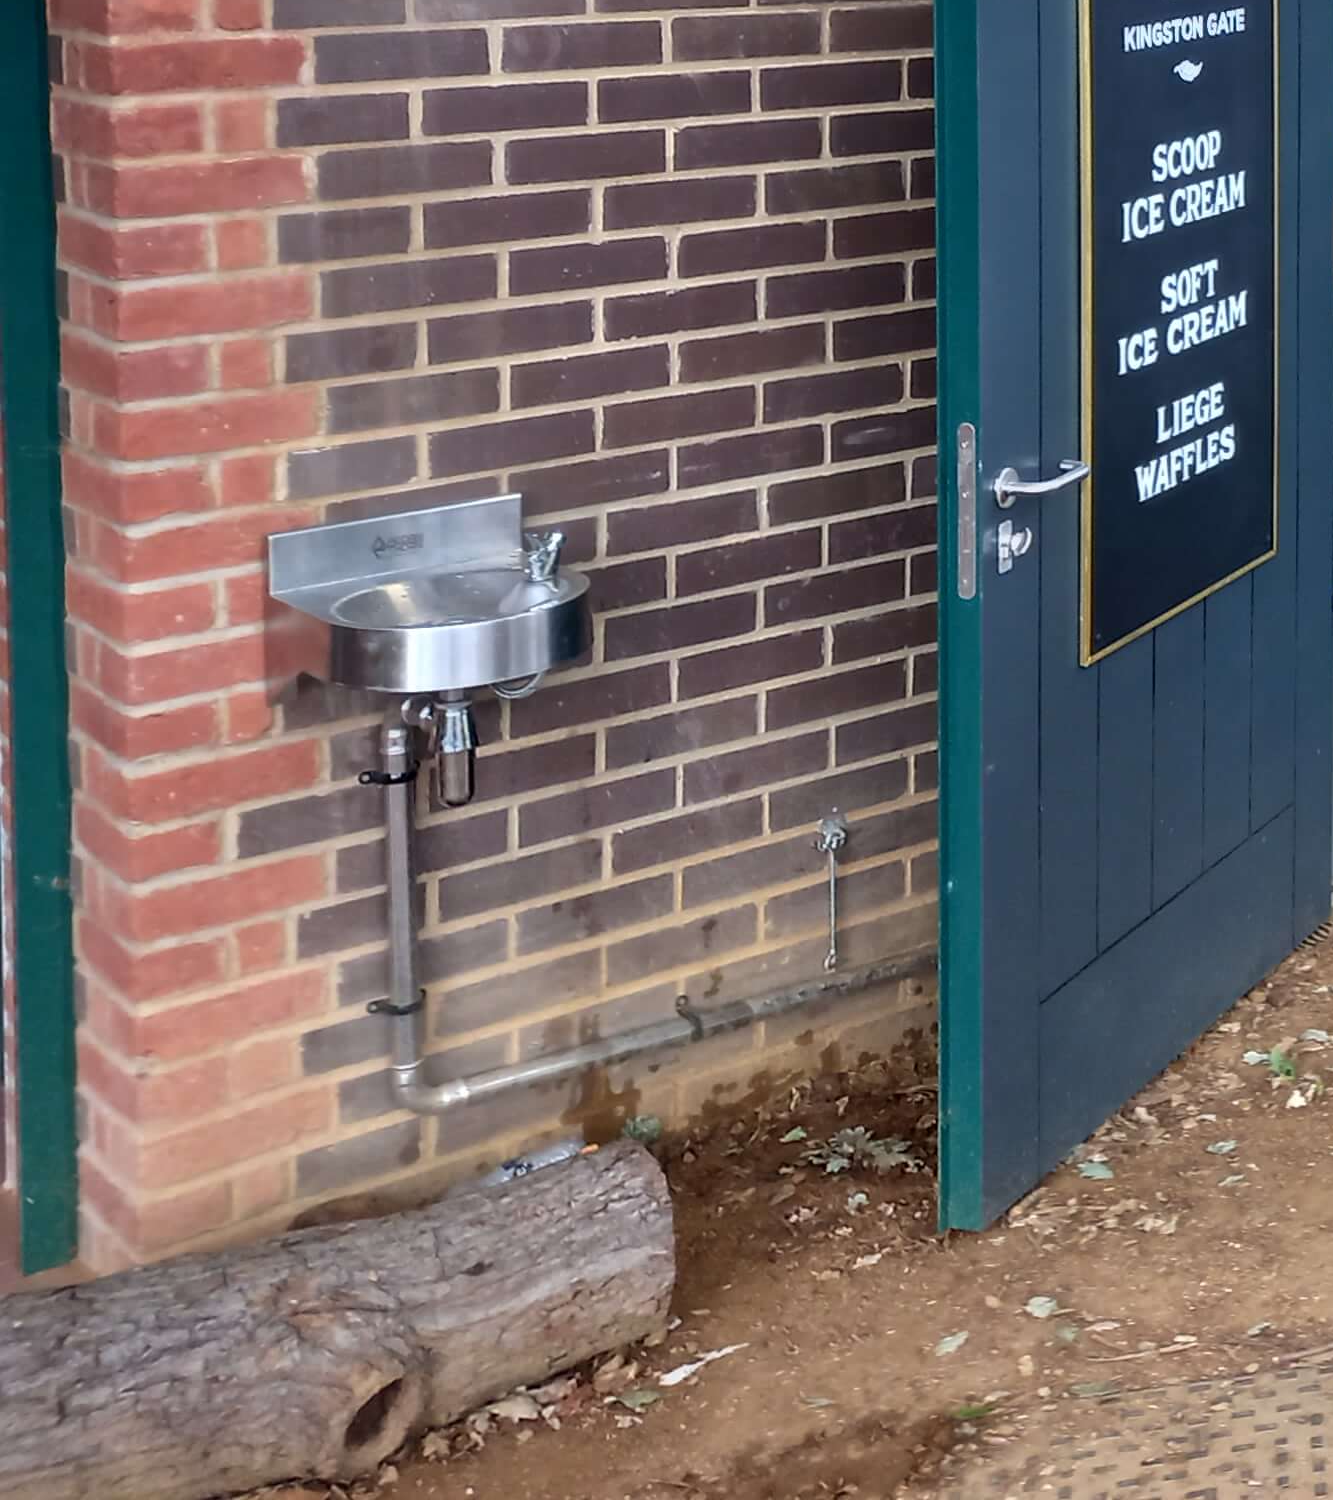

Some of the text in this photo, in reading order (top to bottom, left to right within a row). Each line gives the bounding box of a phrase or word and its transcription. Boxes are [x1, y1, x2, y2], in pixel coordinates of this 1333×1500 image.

[1123, 8, 1246, 52] KINGSTON GATE
[1151, 130, 1222, 182] SCOOP
[1121, 171, 1247, 243] ICE CREAM
[1160, 259, 1219, 315] SOFT
[1117, 290, 1248, 376] ICE CREAM
[1156, 382, 1225, 443] LIEGE
[1134, 424, 1236, 502] WAFFLES
